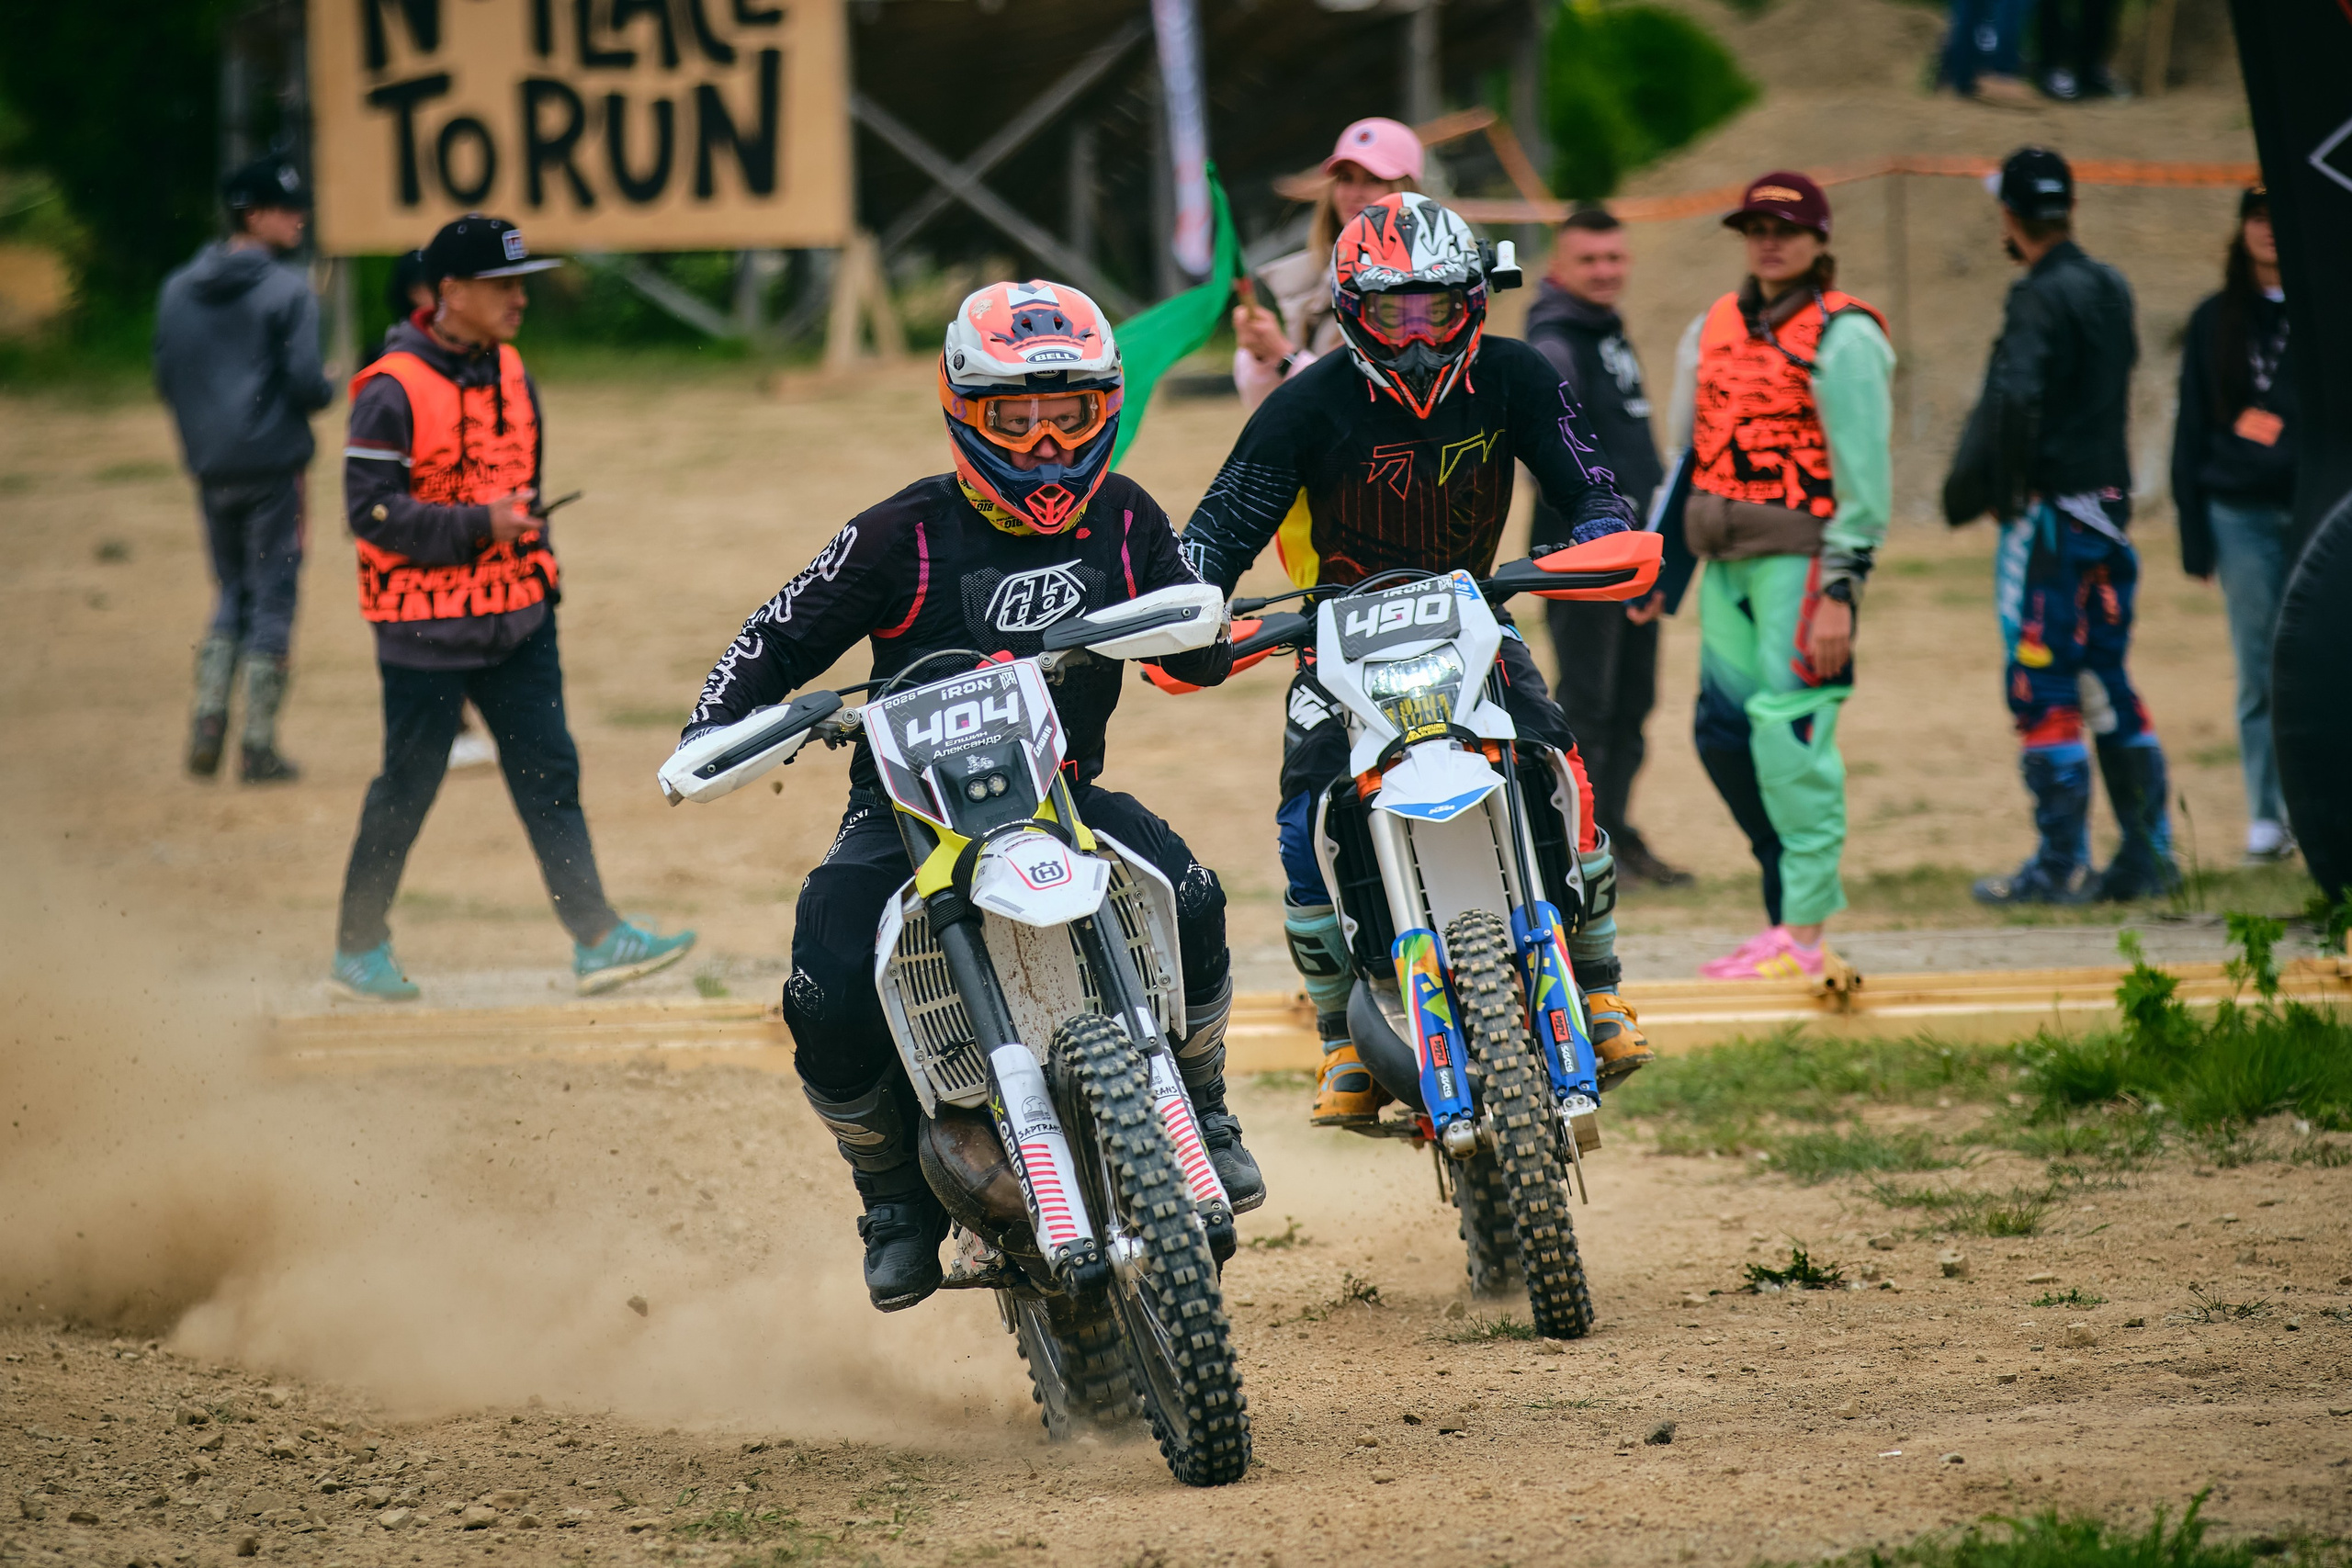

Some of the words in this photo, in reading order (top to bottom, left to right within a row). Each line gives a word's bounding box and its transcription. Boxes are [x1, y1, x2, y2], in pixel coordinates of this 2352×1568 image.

[519, 50, 783, 206] RUN
[1035, 352, 1075, 362] BELL
[1345, 593, 1453, 638] 490
[906, 691, 1020, 749] 404
[933, 734, 1002, 760] Александр
